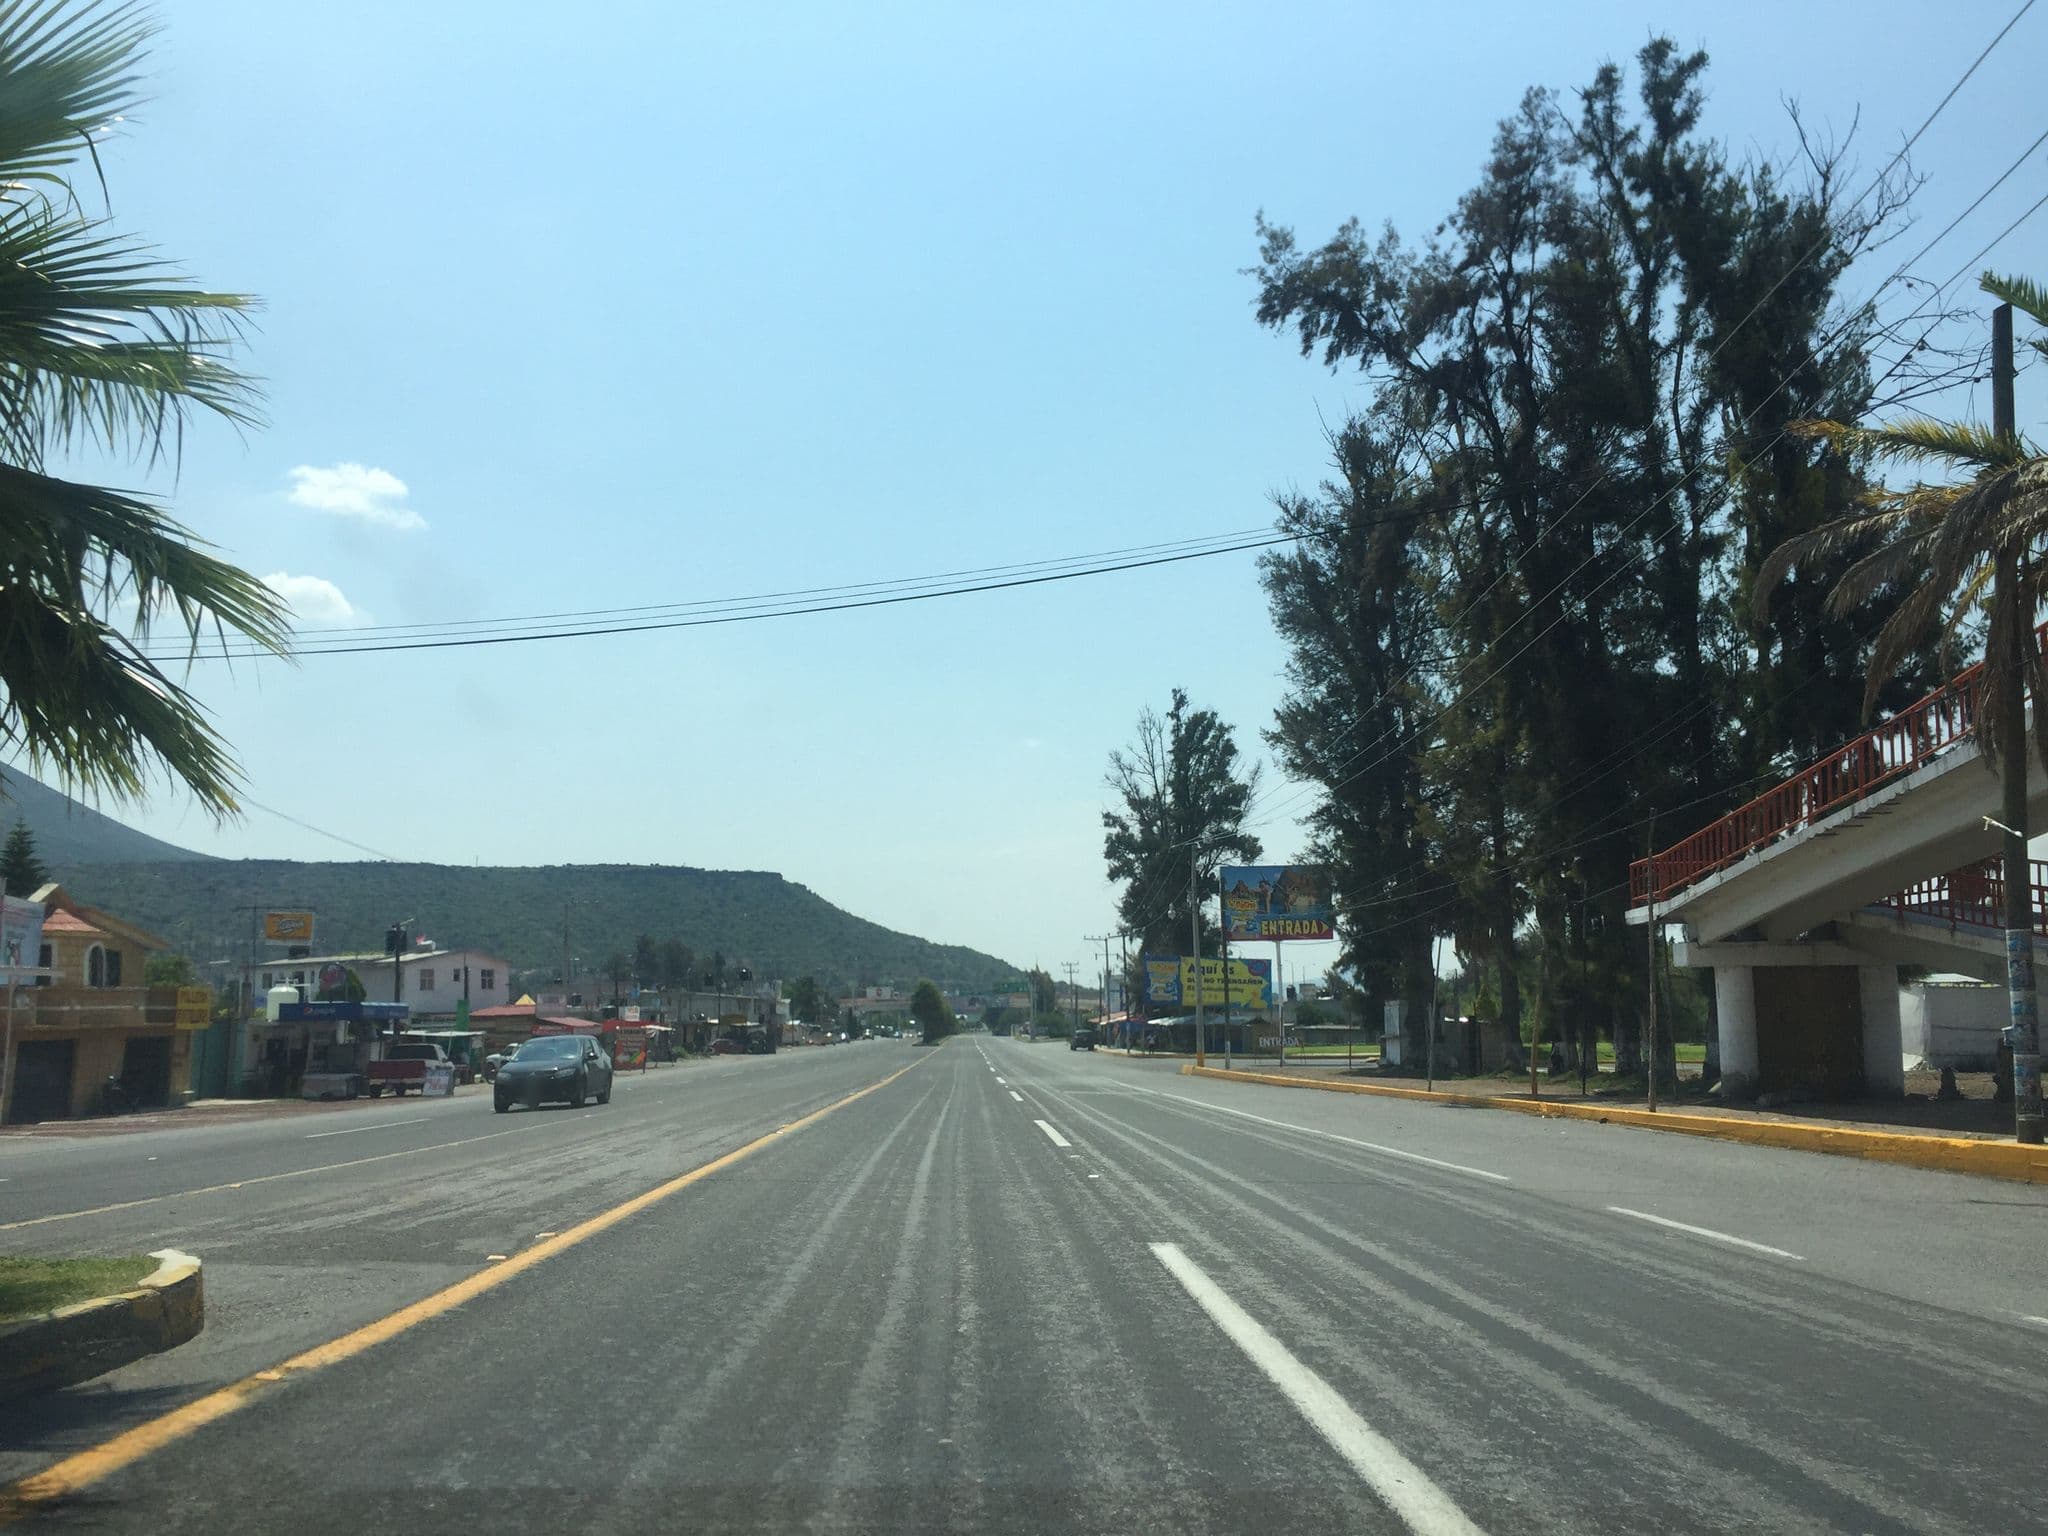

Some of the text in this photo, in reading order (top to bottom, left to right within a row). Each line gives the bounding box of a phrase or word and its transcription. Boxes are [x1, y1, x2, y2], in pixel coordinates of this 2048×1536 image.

[1261, 920, 1318, 936] ENTRADA
[1188, 963, 1217, 976] Aquí
[1259, 1036, 1299, 1048] ENTRADA
